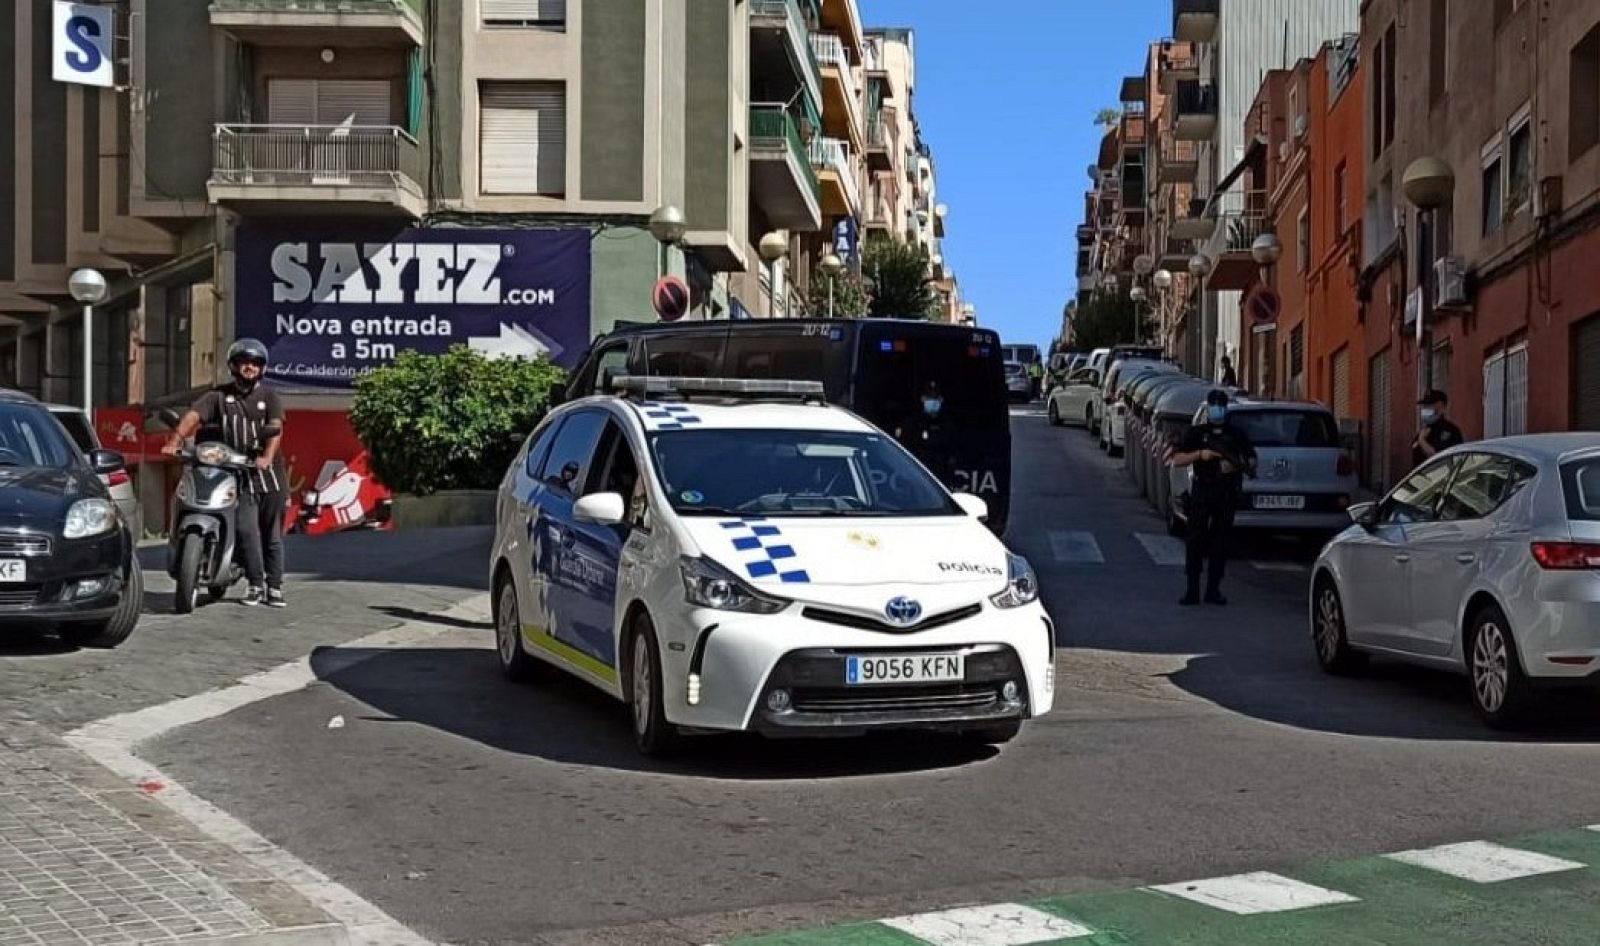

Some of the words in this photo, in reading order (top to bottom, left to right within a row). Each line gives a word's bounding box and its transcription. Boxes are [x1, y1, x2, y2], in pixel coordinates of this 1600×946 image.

[65, 16, 102, 73] S
[270, 242, 501, 304] SAYEZ
[276, 314, 342, 335] Nova
[351, 314, 451, 336] entrada
[331, 342, 346, 359] a
[355, 339, 395, 359] 5m
[296, 363, 355, 376] Calderón
[862, 659, 914, 681] 9056
[921, 656, 959, 678] KFN
